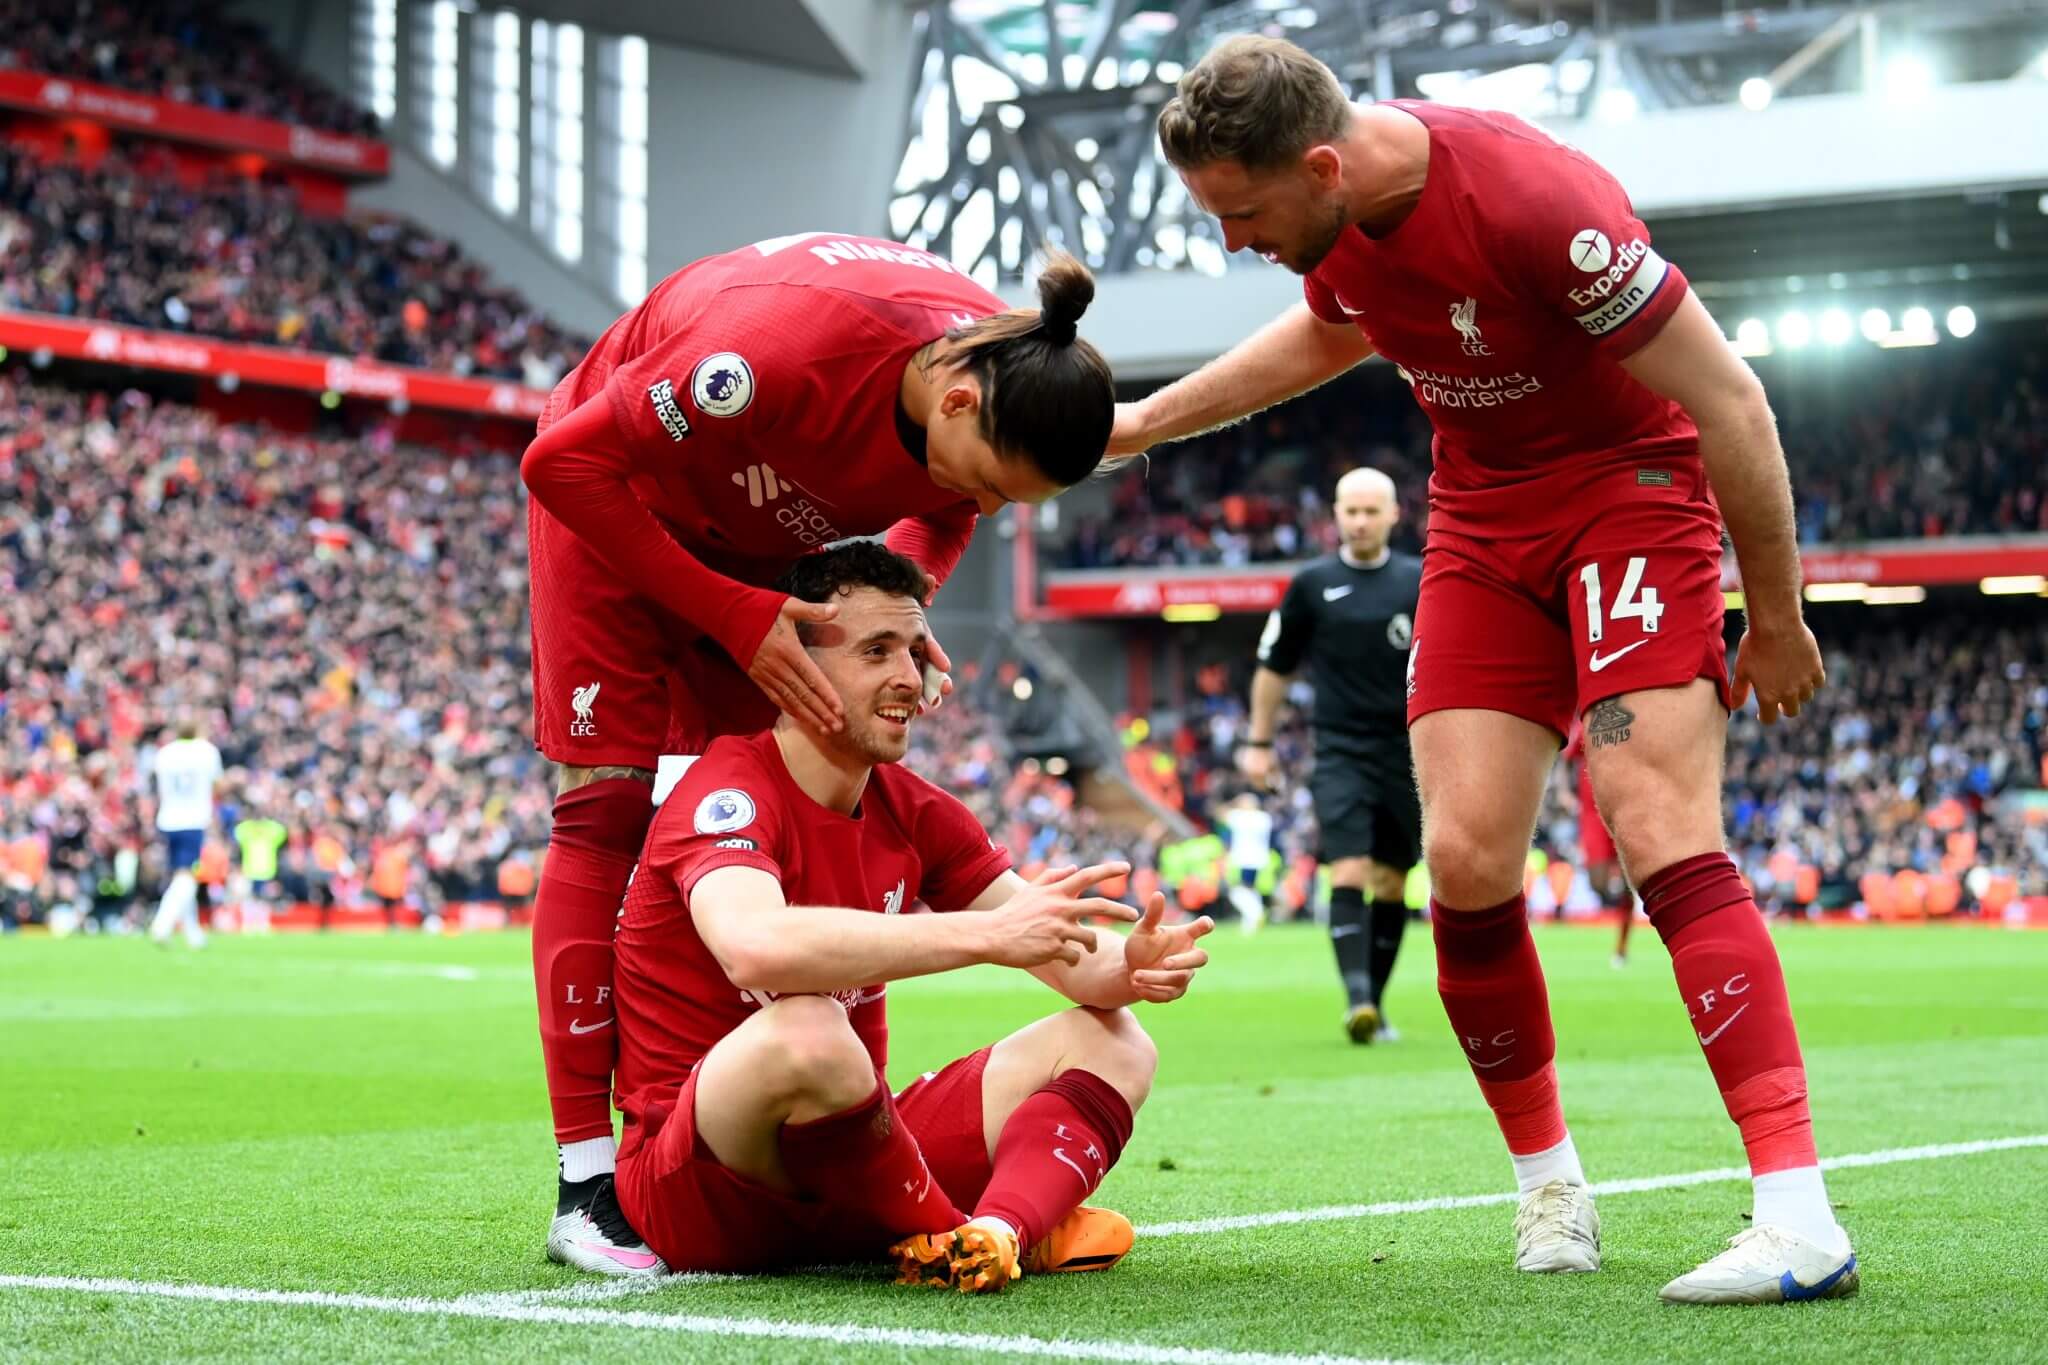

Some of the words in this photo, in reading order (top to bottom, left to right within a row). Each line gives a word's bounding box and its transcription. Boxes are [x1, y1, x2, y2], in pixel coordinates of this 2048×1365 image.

[1567, 238, 1648, 307] Expedia
[1583, 286, 1645, 332] aptain
[659, 378, 673, 401] No
[1422, 376, 1543, 408] chartered
[655, 404, 684, 442] racism
[664, 400, 689, 433] room
[1580, 556, 1665, 643] 14
